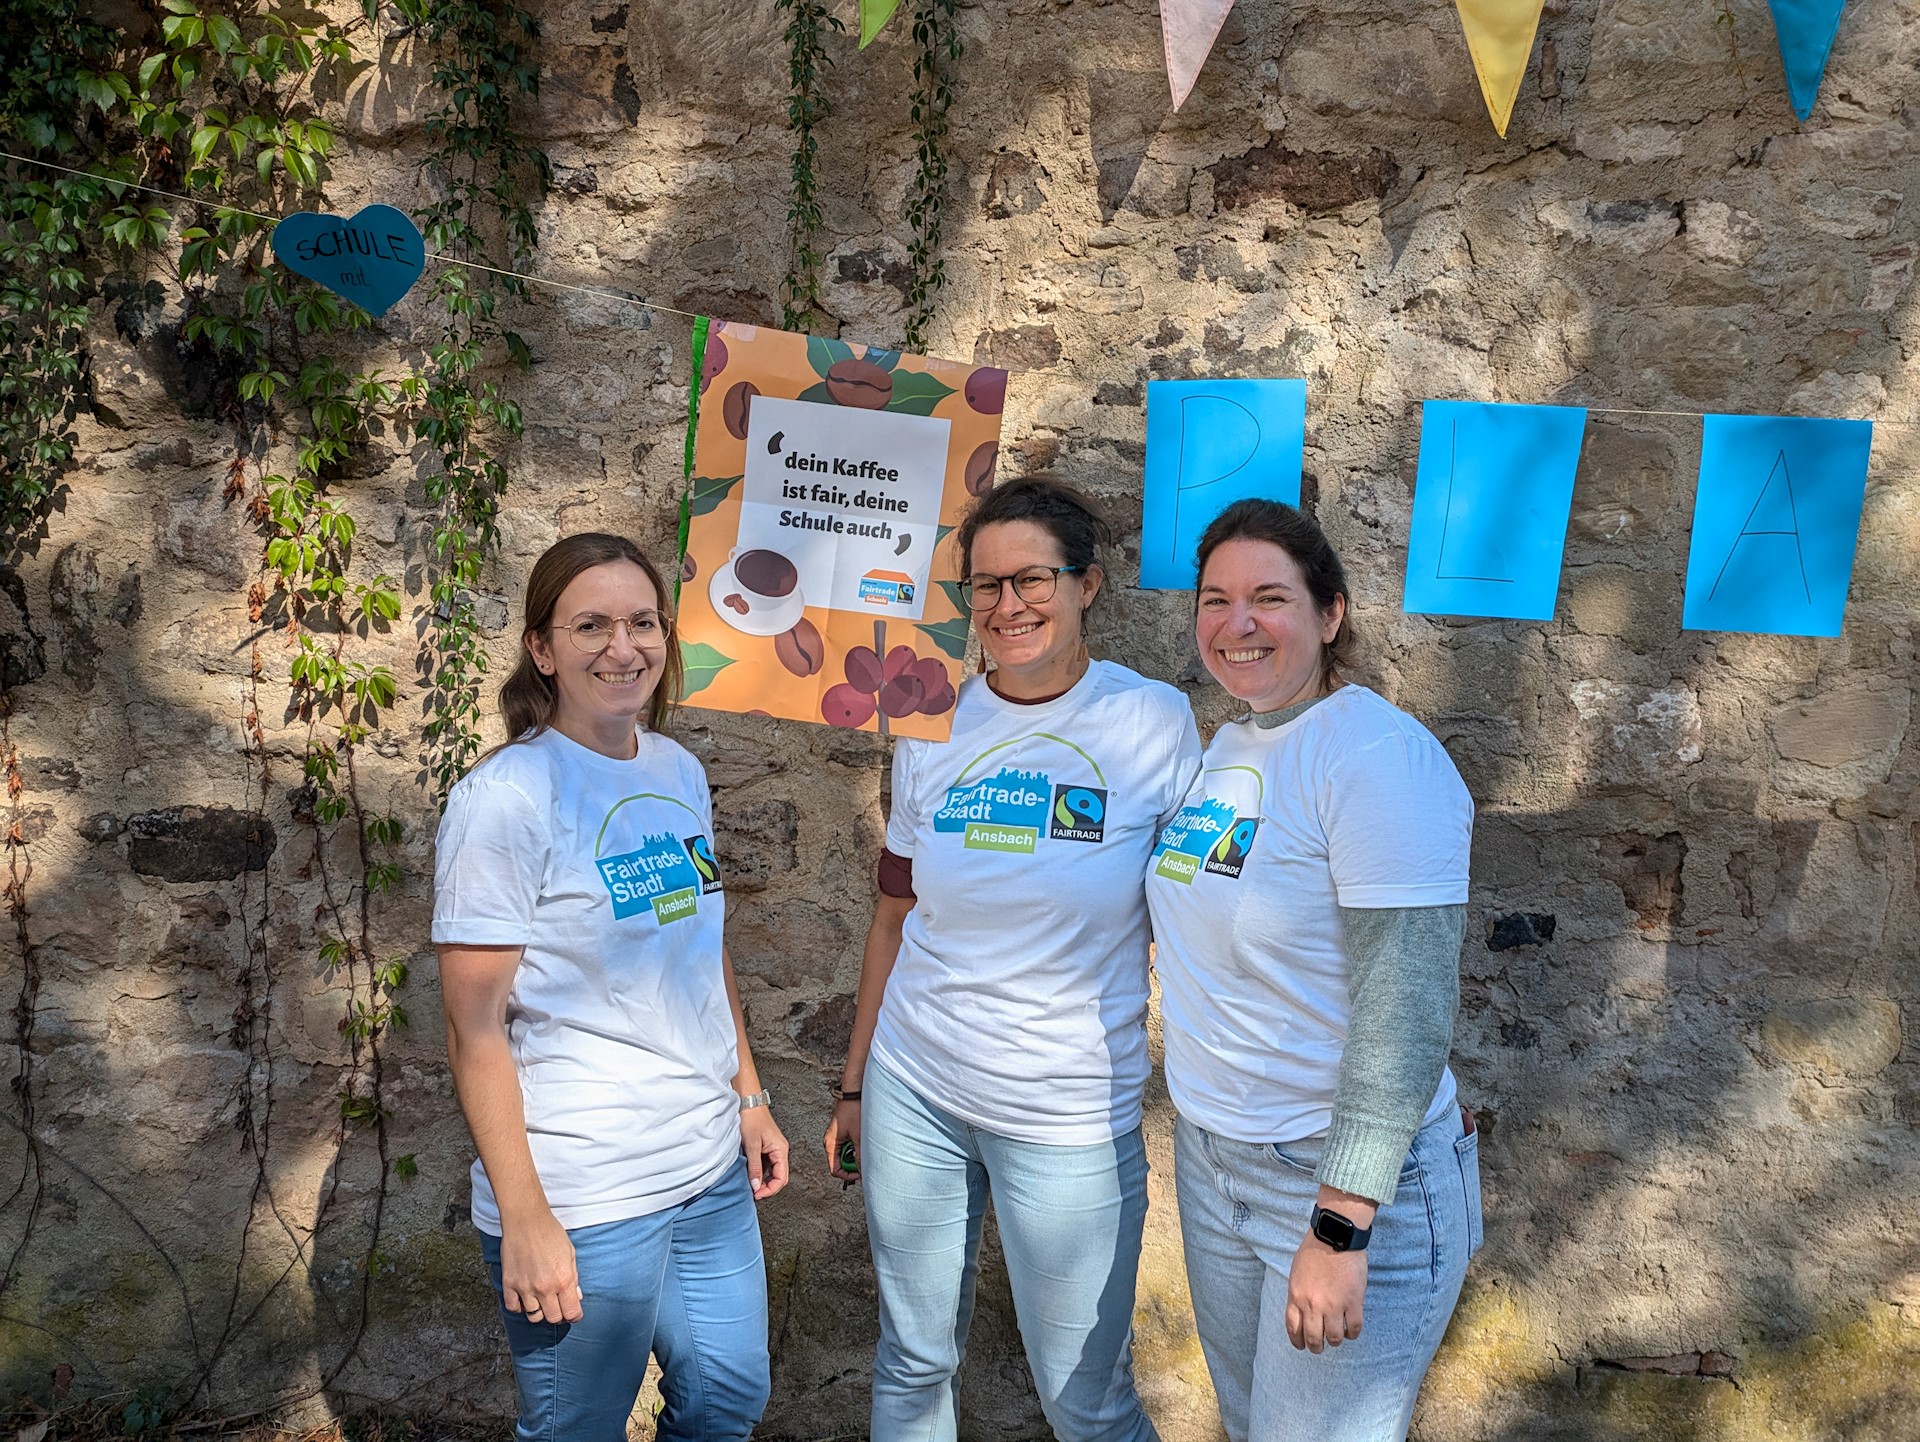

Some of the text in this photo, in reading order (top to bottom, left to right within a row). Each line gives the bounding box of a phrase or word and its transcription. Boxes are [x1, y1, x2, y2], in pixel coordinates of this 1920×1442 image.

[296, 228, 415, 267] SCHULE
[340, 265, 371, 287] mit
[785, 451, 899, 482] dein Kaffee
[782, 479, 909, 513] ist fair, deine
[1172, 395, 1811, 604] P L A
[779, 510, 892, 540] Schule auch
[861, 585, 895, 595] Fairtrade
[948, 784, 1045, 807] Fairtrade-
[938, 802, 992, 820] Stadt
[970, 829, 1032, 846] Ansbach
[1053, 828, 1101, 840] FAIRTRADE
[602, 851, 684, 883] Fairtrade-
[1161, 856, 1196, 876] Ansbach
[1207, 861, 1240, 876] FAIRTRADE
[612, 873, 665, 903] Stadt
[659, 894, 695, 916] Ansbach
